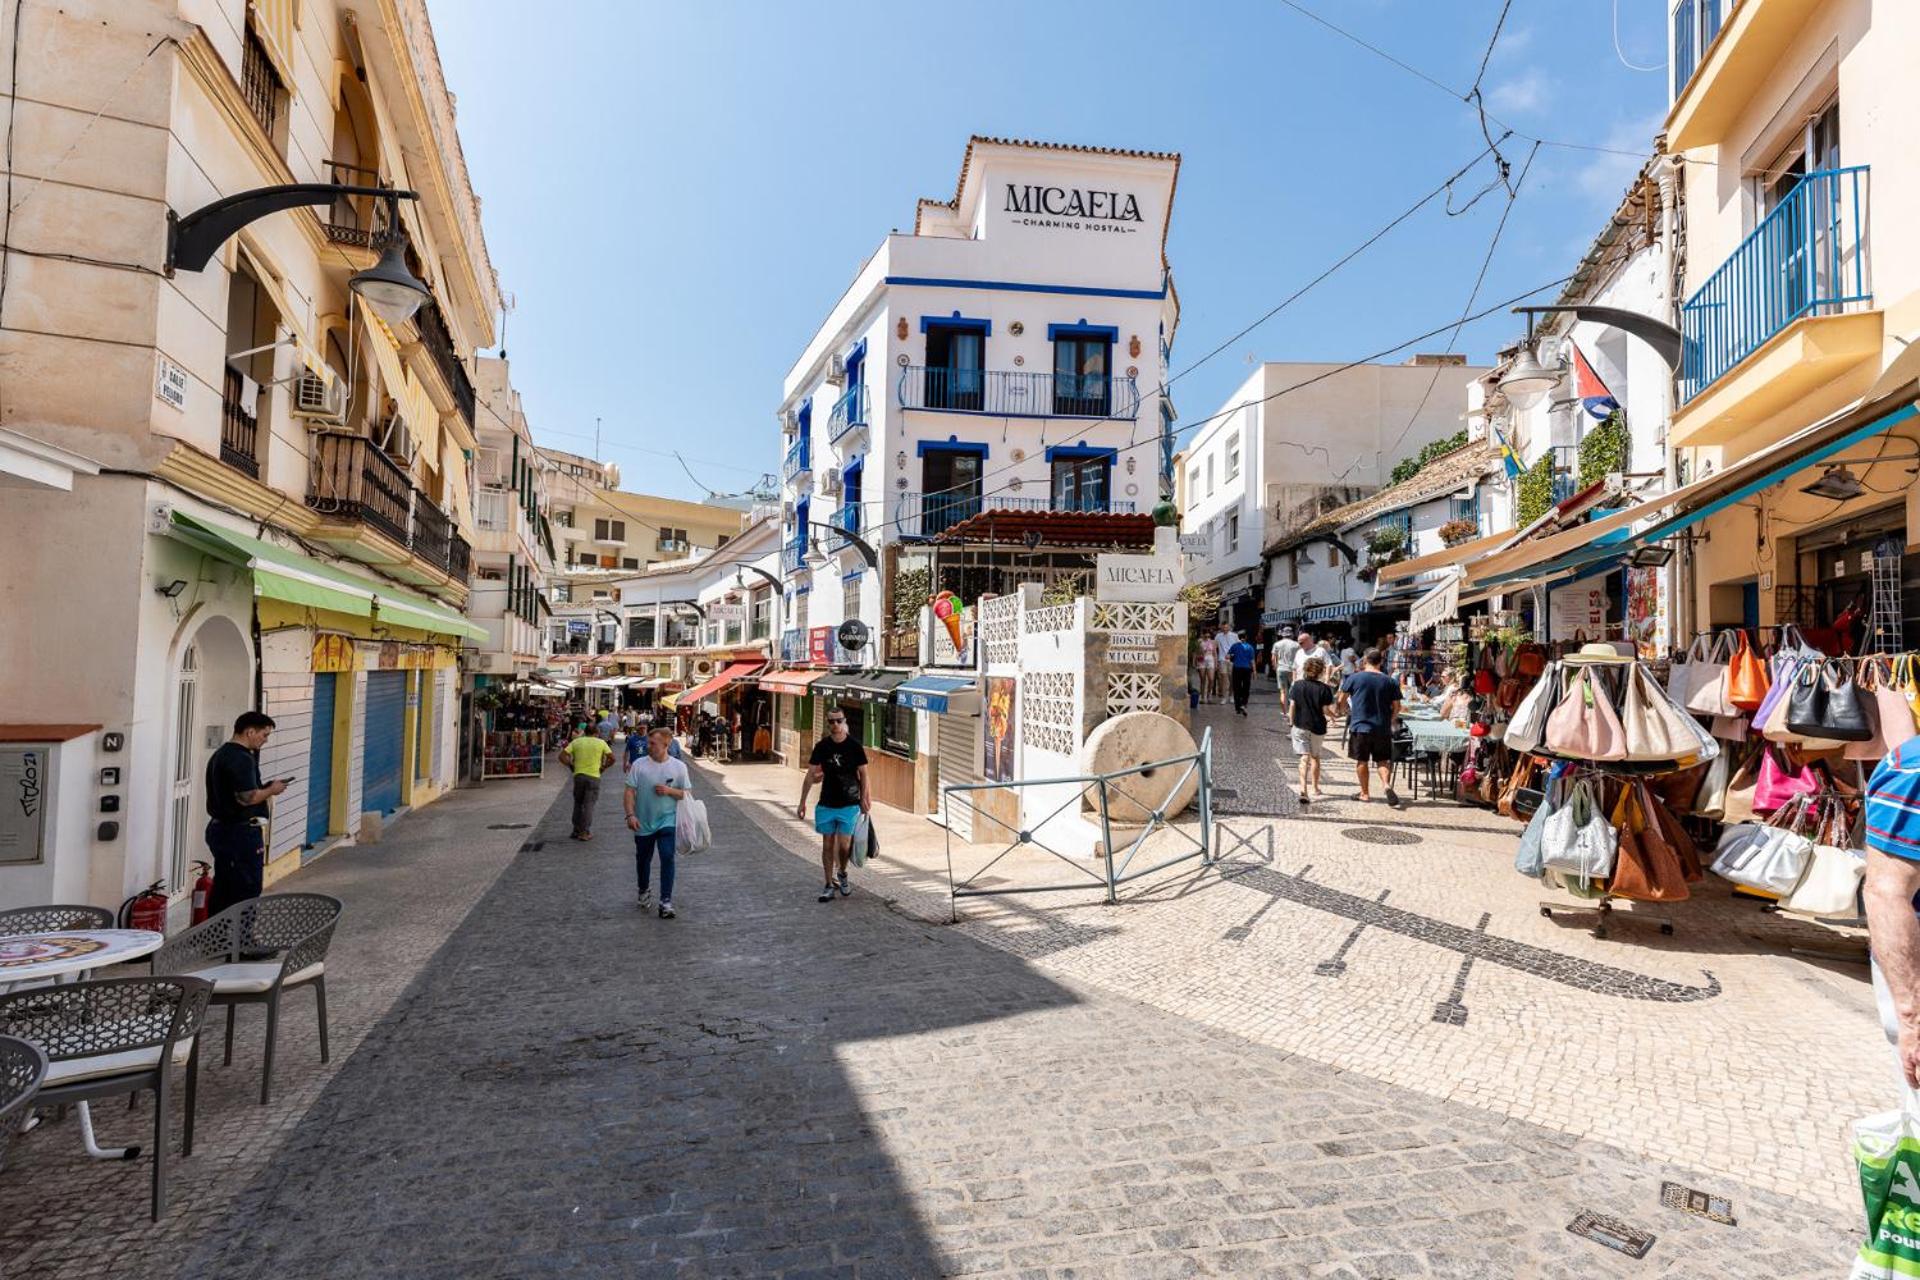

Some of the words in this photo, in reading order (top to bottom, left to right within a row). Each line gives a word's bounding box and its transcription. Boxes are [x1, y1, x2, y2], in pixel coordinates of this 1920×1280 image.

[1004, 184, 1144, 222] MICAELA
[1023, 218, 1080, 230] CHARMING
[1085, 223, 1126, 234] HOSTAL
[1105, 567, 1174, 584] MICAELA
[1112, 635, 1154, 646] HOSTAL
[1108, 651, 1157, 662] MICAELA
